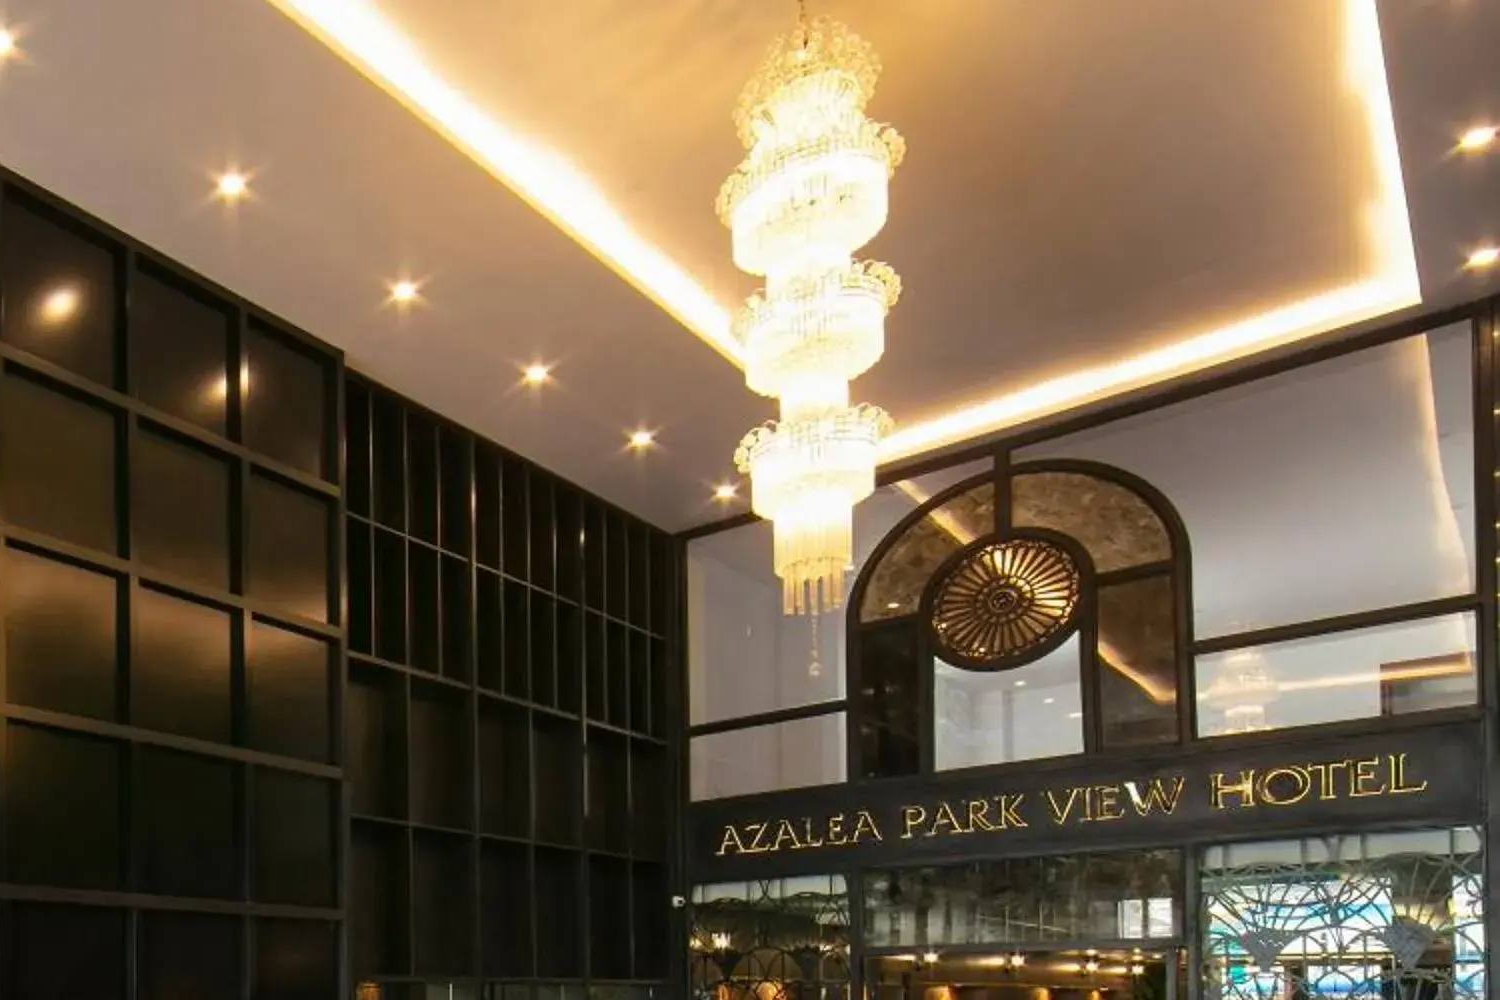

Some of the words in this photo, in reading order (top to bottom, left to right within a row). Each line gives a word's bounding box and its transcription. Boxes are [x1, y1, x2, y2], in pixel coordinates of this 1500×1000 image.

[715, 811, 883, 856] AZALEA
[900, 793, 1029, 840] PARK
[1042, 776, 1185, 825] VIEW
[1210, 752, 1428, 810] HOTEL
